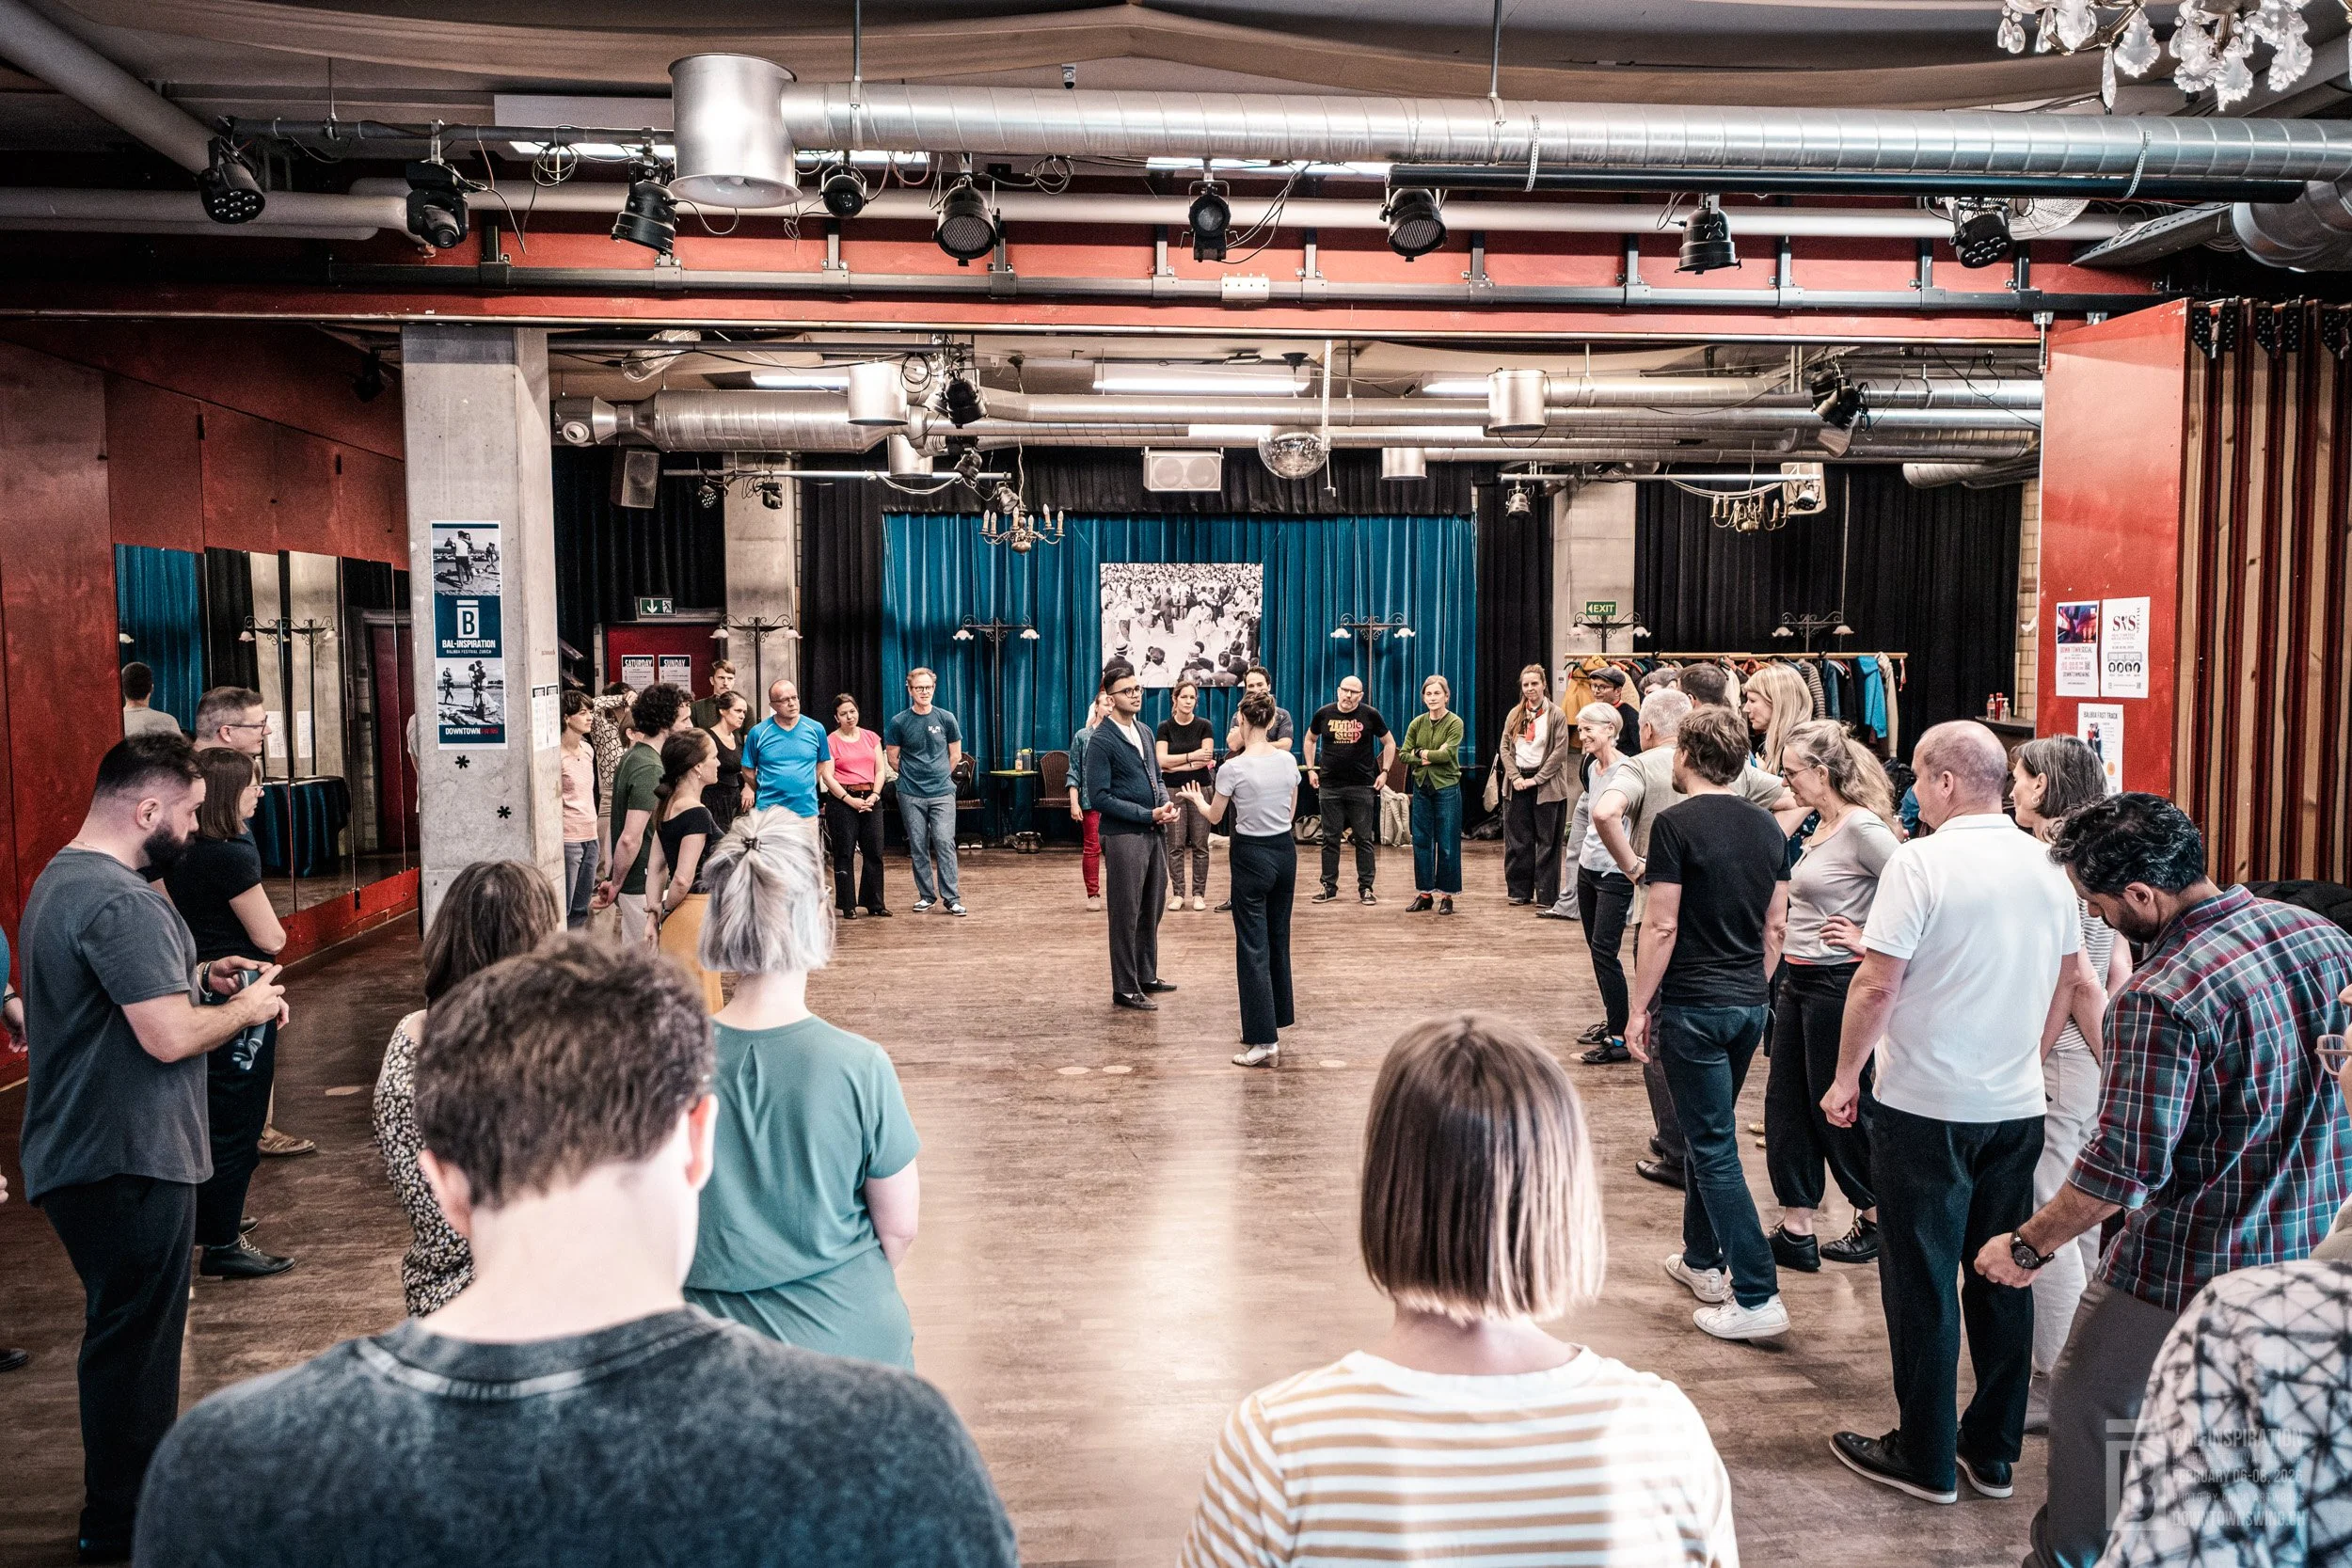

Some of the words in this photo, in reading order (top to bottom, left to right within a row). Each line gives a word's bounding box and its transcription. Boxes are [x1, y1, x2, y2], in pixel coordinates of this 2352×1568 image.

[1594, 604, 1614, 613] EXIT
[442, 639, 496, 649] BAL-INSPIRATION
[625, 659, 653, 668] SATURDAY
[663, 659, 686, 668] SUNDAY
[1329, 720, 1362, 731] Triple
[1336, 731, 1359, 740] step
